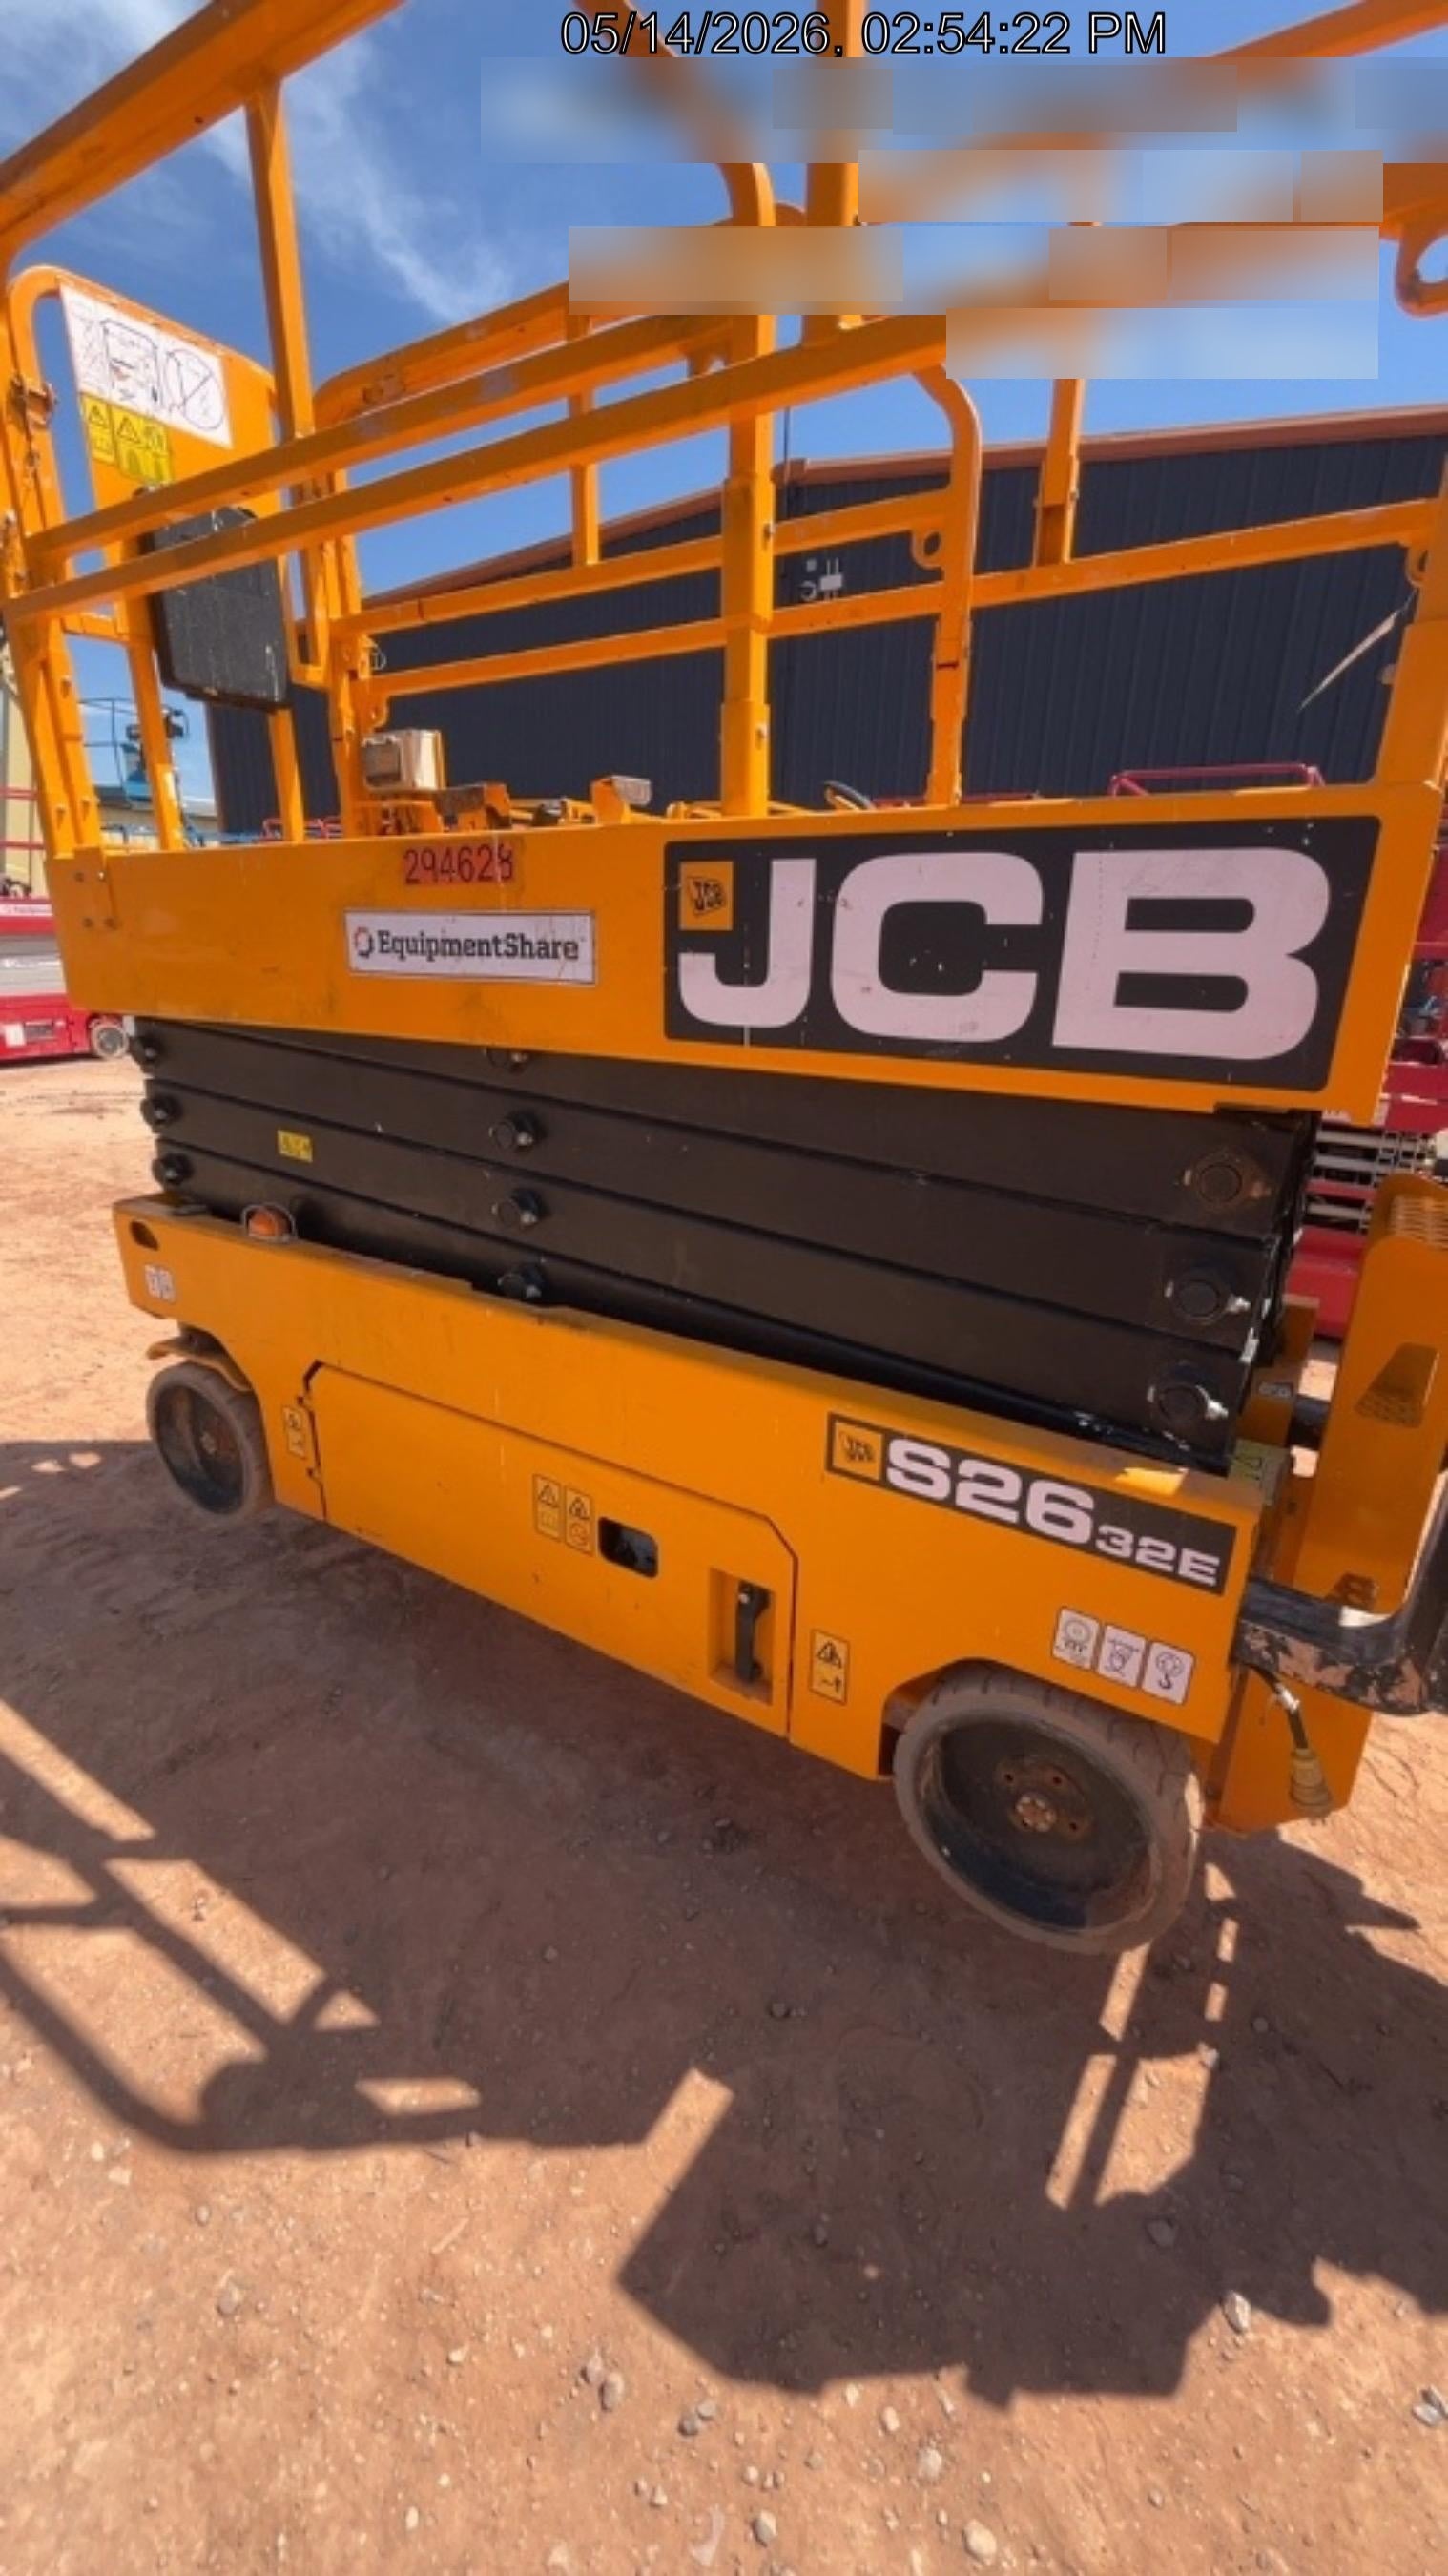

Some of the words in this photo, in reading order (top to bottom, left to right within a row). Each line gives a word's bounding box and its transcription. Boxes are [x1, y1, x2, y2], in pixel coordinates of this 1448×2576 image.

[403, 843, 515, 884] 294628
[378, 928, 580, 962] EquipmentShare
[678, 846, 1331, 1060] JCB
